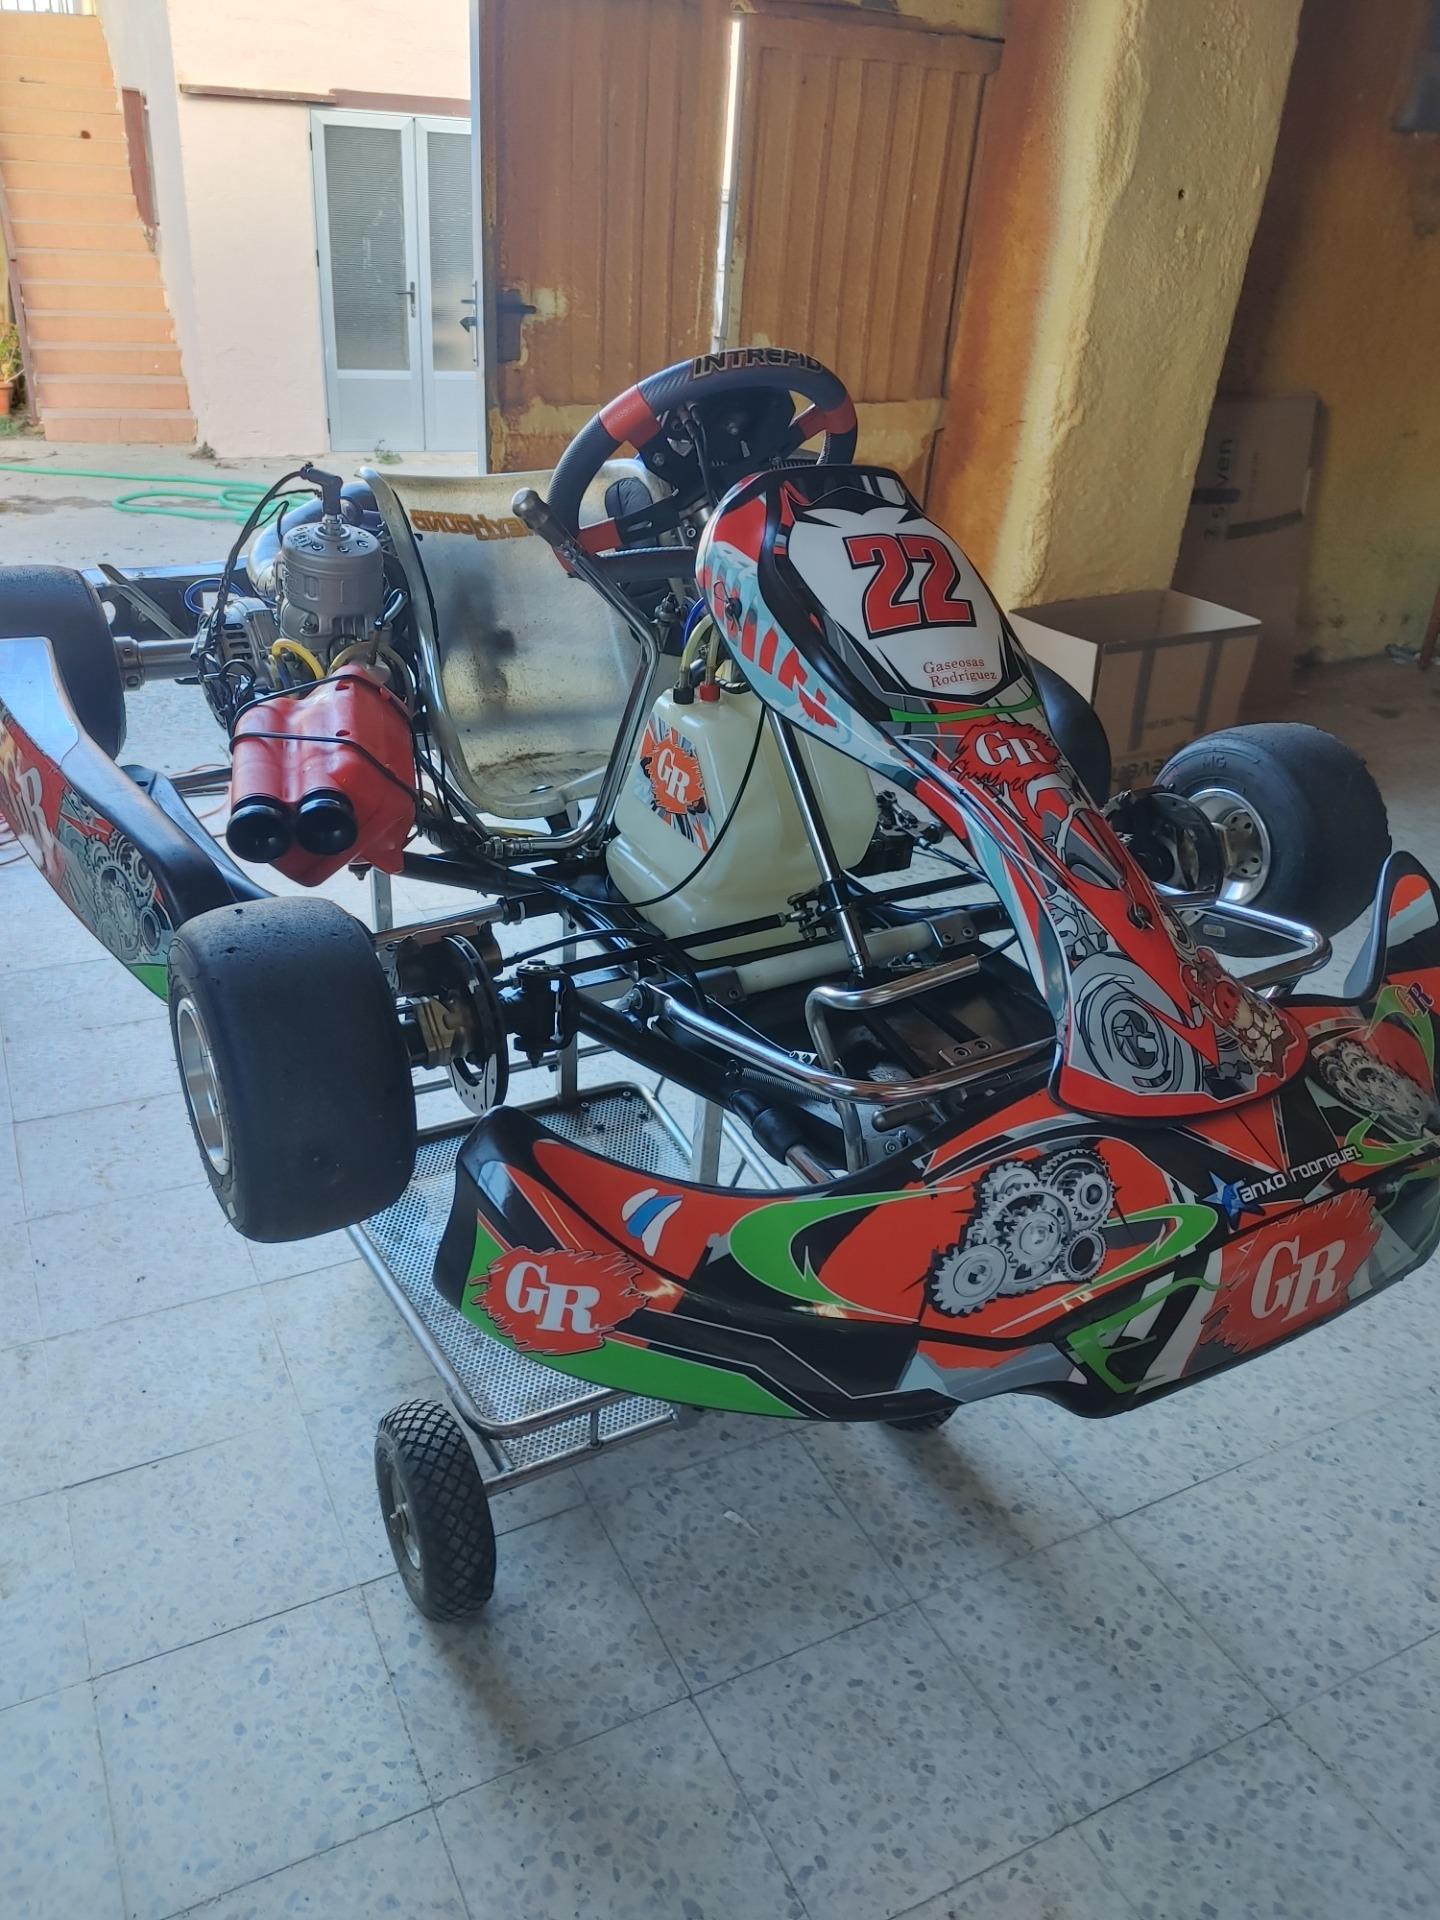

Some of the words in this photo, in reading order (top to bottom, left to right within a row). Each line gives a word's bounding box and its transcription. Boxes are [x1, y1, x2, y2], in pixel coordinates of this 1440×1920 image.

[693, 347, 823, 379] INTREPID
[842, 533, 977, 640] 22
[923, 658, 985, 674] Gaseosas
[657, 748, 690, 805] GR
[975, 731, 1050, 767] GR
[505, 1261, 601, 1334] GR
[1250, 1235, 1346, 1322] GR
